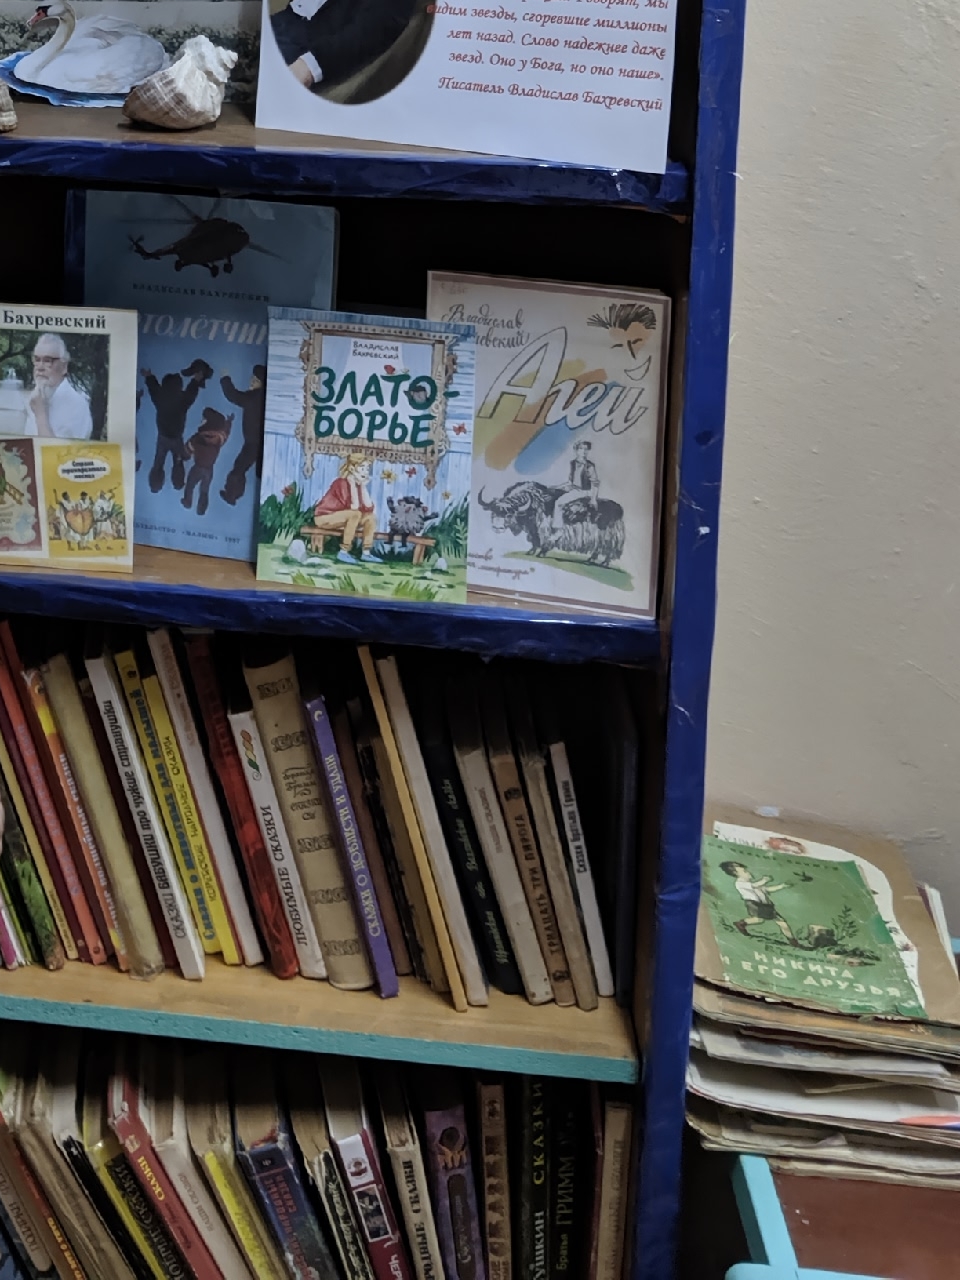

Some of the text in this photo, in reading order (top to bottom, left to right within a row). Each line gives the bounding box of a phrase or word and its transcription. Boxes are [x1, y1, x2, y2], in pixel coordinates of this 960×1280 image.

[426, 4, 667, 33] видим звезды, сгоревшие миллионы
[447, 29, 667, 59] лет назад. Слово надежнее даже
[449, 51, 664, 81] звезд. Оно у Бога, но оно наше».
[437, 76, 662, 111] Писатель Владислав Бахревский
[3, 310, 106, 329] Бахревский
[352, 350, 399, 360] БАХРЕВСКИЙ
[353, 341, 399, 352] ВЛАДИСЛАВ
[311, 366, 460, 410] ЗЛАТО-
[476, 326, 651, 435] Агей
[311, 404, 437, 449] БОРЬЕ
[129, 687, 162, 759] малышей
[99, 698, 189, 939] СКАЗКИ БАБУШКИ про чужие странушки
[161, 792, 196, 871] животных
[324, 754, 382, 937] СКАЗКИ О ДОБЛЕСТИ И УДАЛИ
[575, 844, 588, 874] Сказки
[260, 805, 308, 946] ЛЮБИМЫЕ СКАЗКИ
[515, 814, 561, 956] ТРИДЦАТЬ ТРИ ПИРОГА
[741, 961, 787, 979] ЕГО
[803, 975, 901, 997] ДРУЗЬЯ
[754, 951, 855, 980] НИКИТА
[532, 1081, 544, 1186] СКАЗКИ
[113, 1162, 153, 1226] СКАЗКИ
[137, 1154, 166, 1202] СКАЗКИ
[402, 1159, 422, 1214] СКАЗКИ
[554, 1155, 577, 1227] ГРИММ
[8, 1201, 39, 1253] ПОДАРКИ
[554, 1231, 569, 1271] Братья
